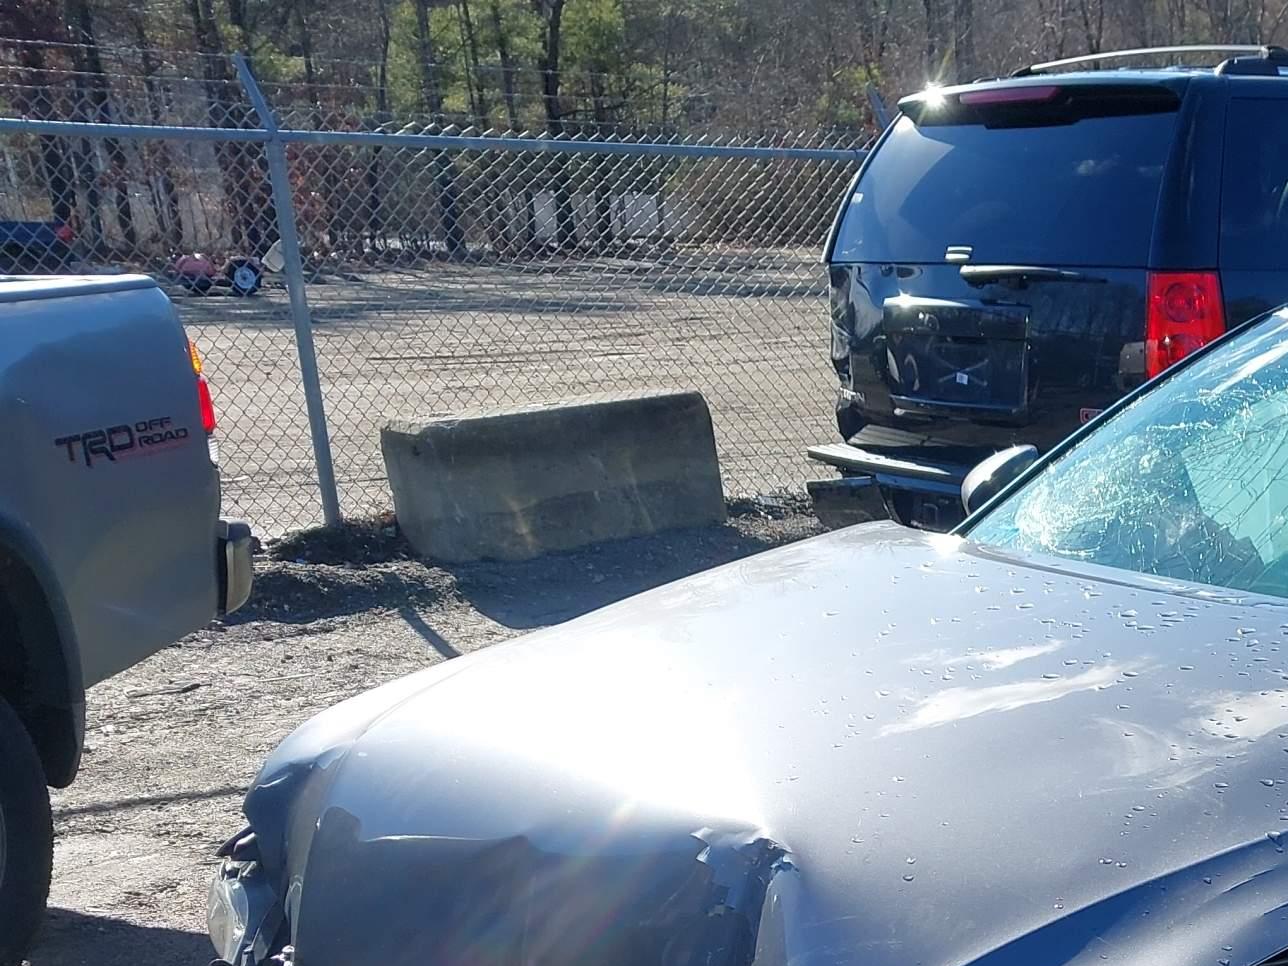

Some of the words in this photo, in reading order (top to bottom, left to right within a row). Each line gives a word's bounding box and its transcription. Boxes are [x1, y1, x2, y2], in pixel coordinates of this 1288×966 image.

[135, 416, 171, 432] OFF
[54, 424, 135, 467] TRD
[138, 428, 188, 448] ROAD
